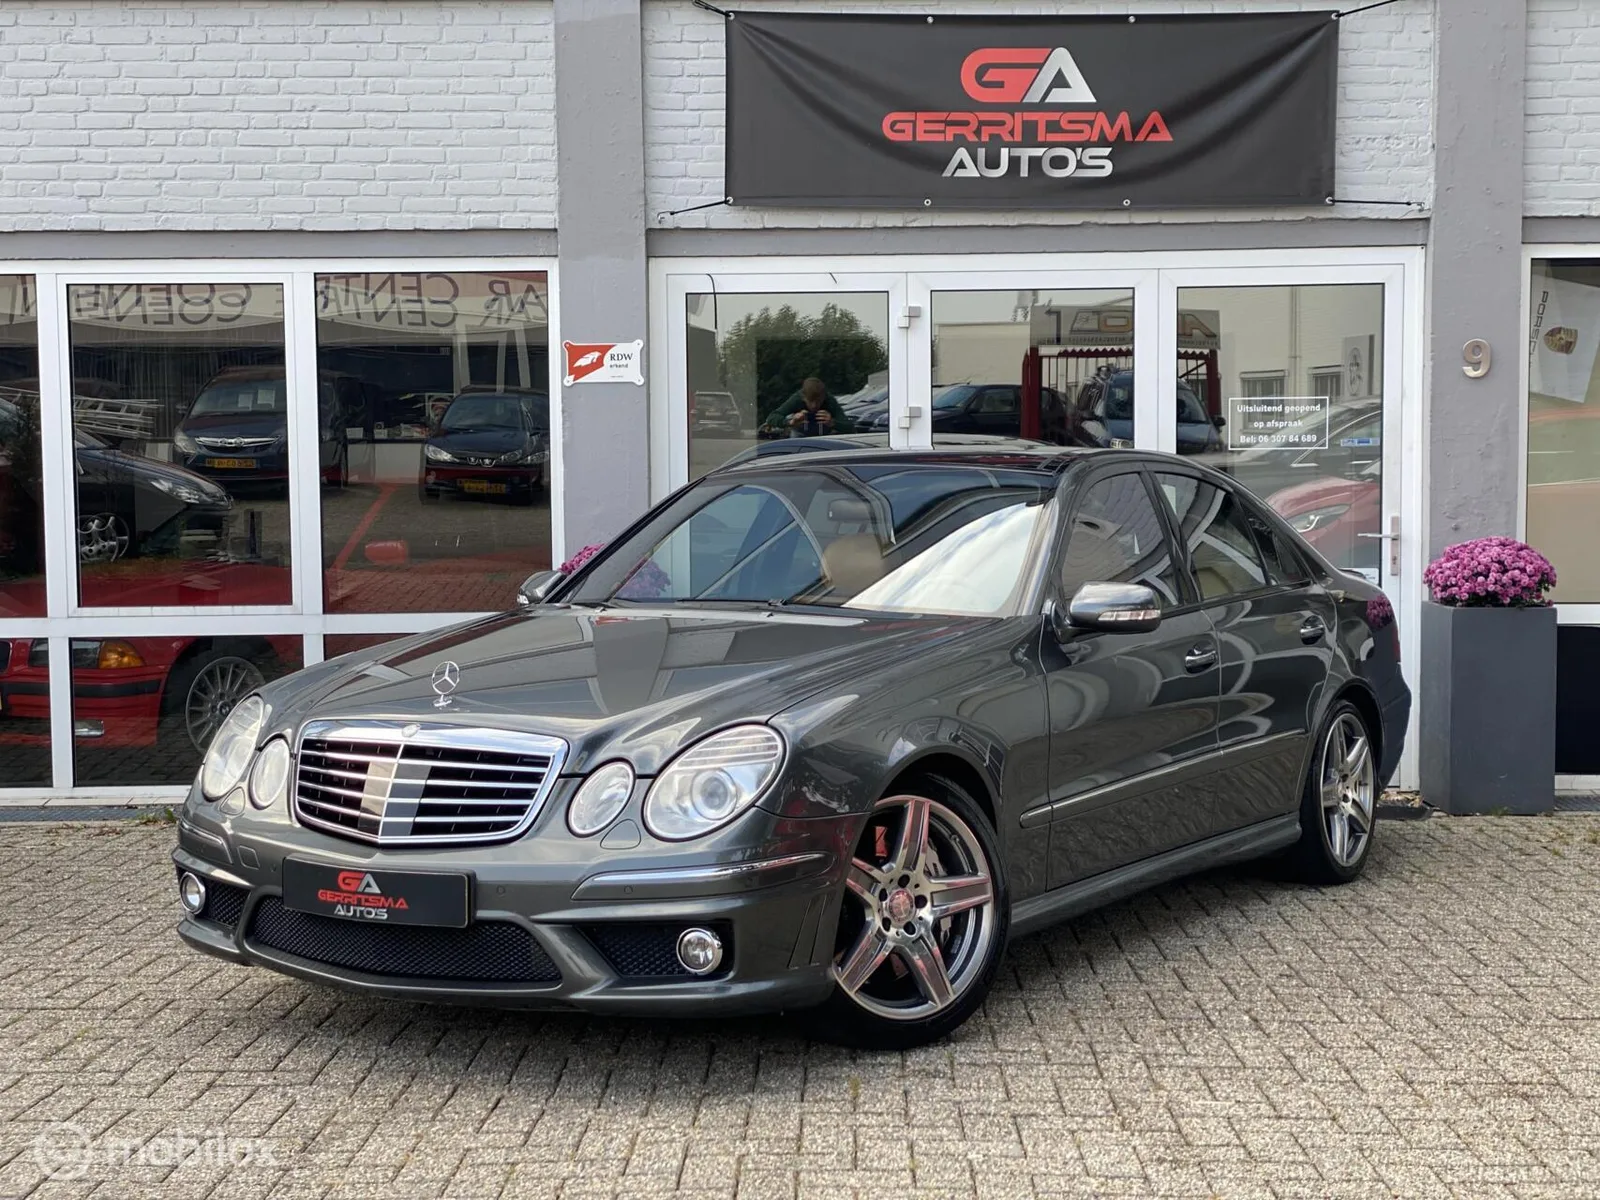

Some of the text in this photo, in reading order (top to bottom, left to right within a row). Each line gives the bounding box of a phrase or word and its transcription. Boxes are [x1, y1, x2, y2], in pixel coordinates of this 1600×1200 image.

[960, 47, 1097, 103] GA
[882, 110, 1174, 142] GERRITSMA
[941, 147, 1113, 178] AUTO'S
[1530, 290, 1549, 367] PORSC
[609, 353, 633, 361] RDW
[1462, 338, 1491, 379] 9
[1236, 403, 1321, 414] Uitsluitend geopend
[1253, 419, 1303, 429] op afspraak
[1239, 434, 1317, 444] Bel: 06 307 84 689
[337, 870, 382, 894] GA
[318, 889, 409, 910] GERRITSMA
[334, 905, 388, 921] AUTO'S
